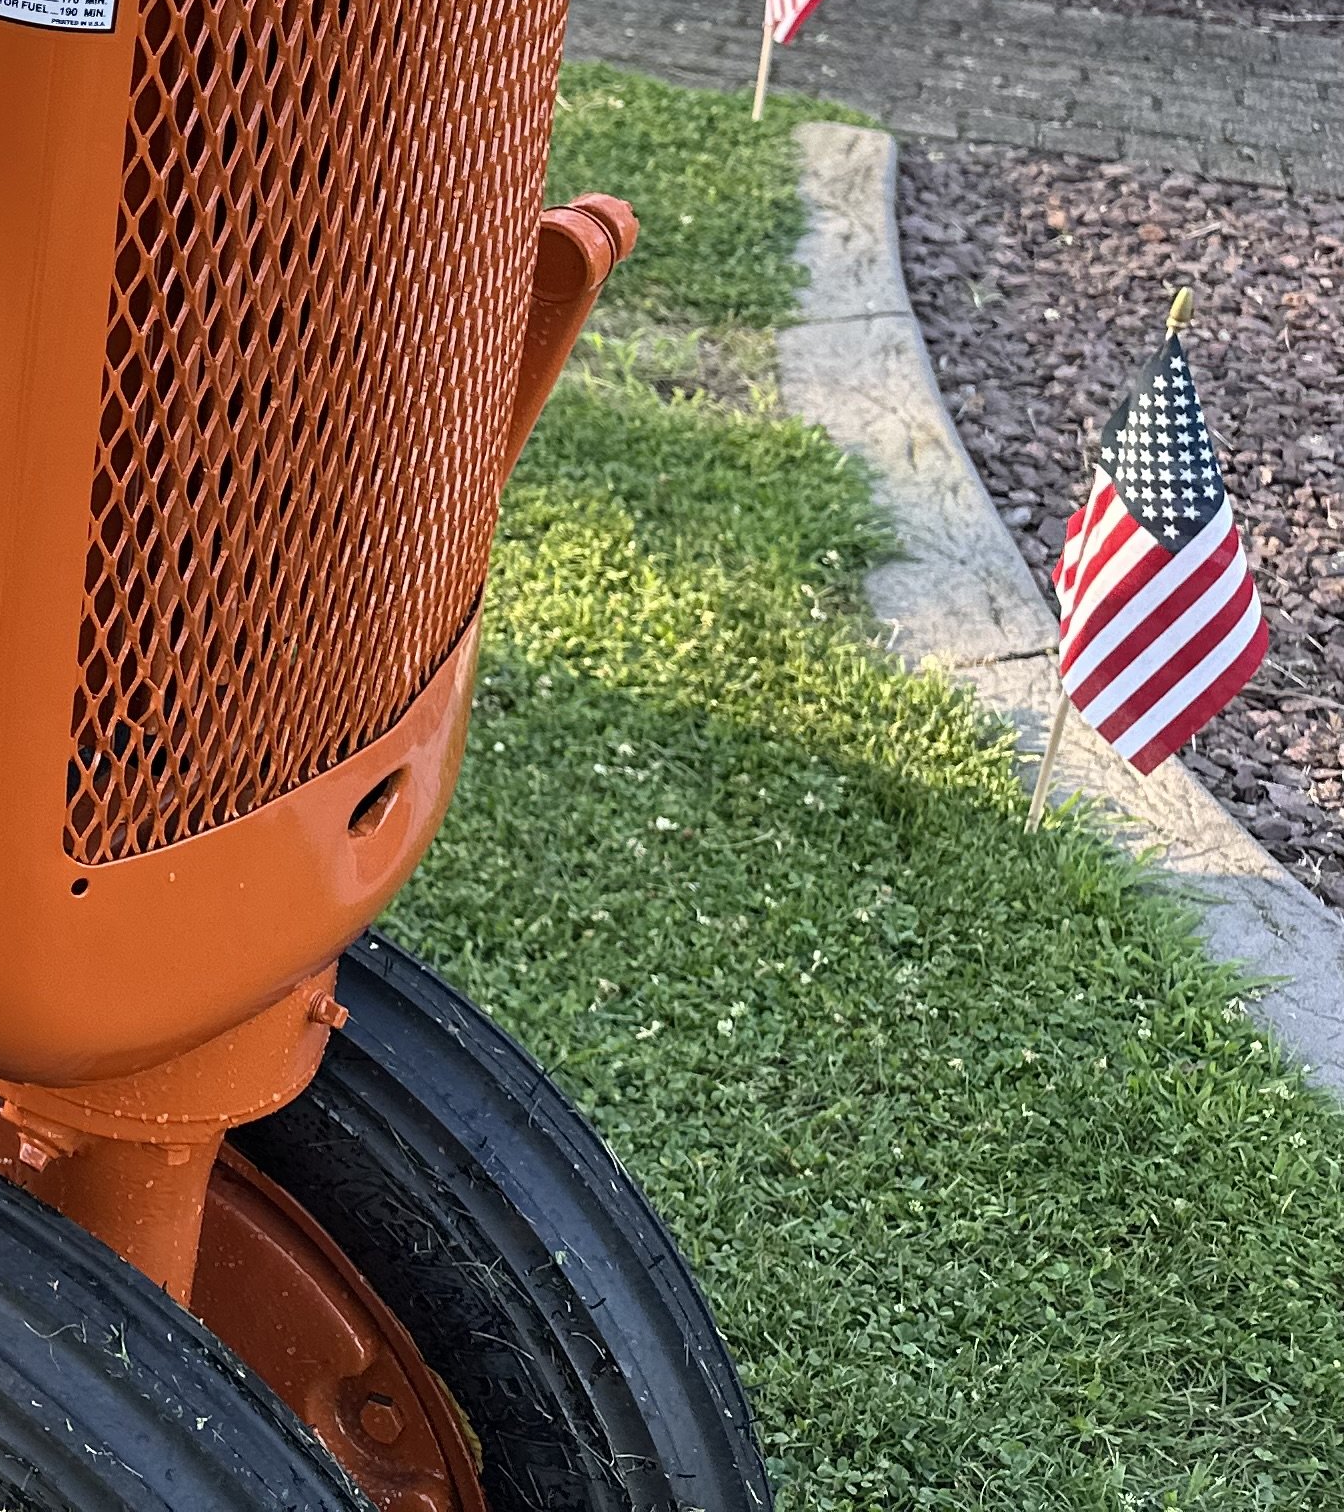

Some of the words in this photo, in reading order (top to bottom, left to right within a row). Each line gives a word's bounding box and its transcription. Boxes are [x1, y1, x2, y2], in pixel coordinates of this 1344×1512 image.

[21, 1, 48, 14] FUEL
[60, 7, 78, 17] 190
[84, 8, 106, 18] MIN.
